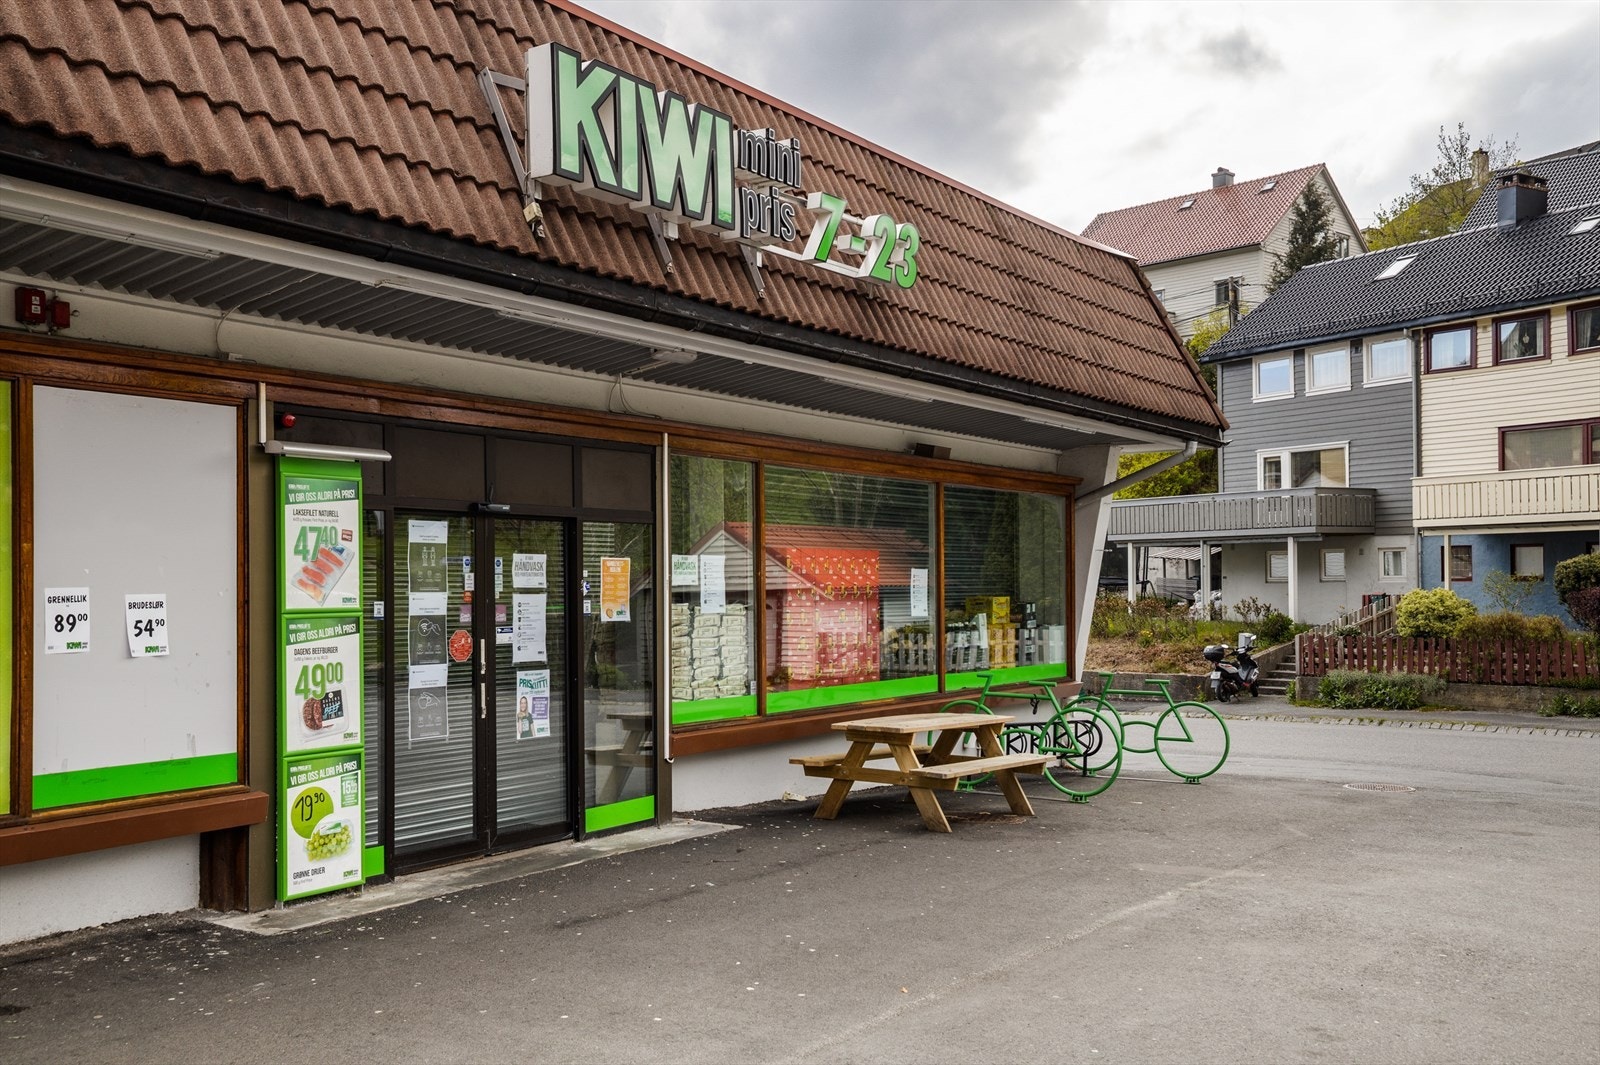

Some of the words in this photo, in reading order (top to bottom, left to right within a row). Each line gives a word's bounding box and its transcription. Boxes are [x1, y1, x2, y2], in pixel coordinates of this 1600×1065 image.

[551, 42, 735, 231] KIWI
[737, 127, 801, 188] mini
[740, 184, 796, 243] pris
[814, 191, 920, 289] 7-23
[305, 491, 317, 501] OSS
[292, 508, 318, 517] LAKSEFILET
[318, 509, 339, 518] NATURELL
[514, 558, 544, 572] HÅNDVASK
[47, 594, 87, 604] GRENNELLIK
[127, 601, 165, 610] BRUDESLØR
[307, 629, 318, 640] OSS
[294, 647, 311, 656] DAGENS
[311, 646, 339, 655] BEEFBURGER
[308, 770, 319, 782] OSS
[292, 869, 311, 880] GRØNNE
[310, 866, 326, 877] DRUER
